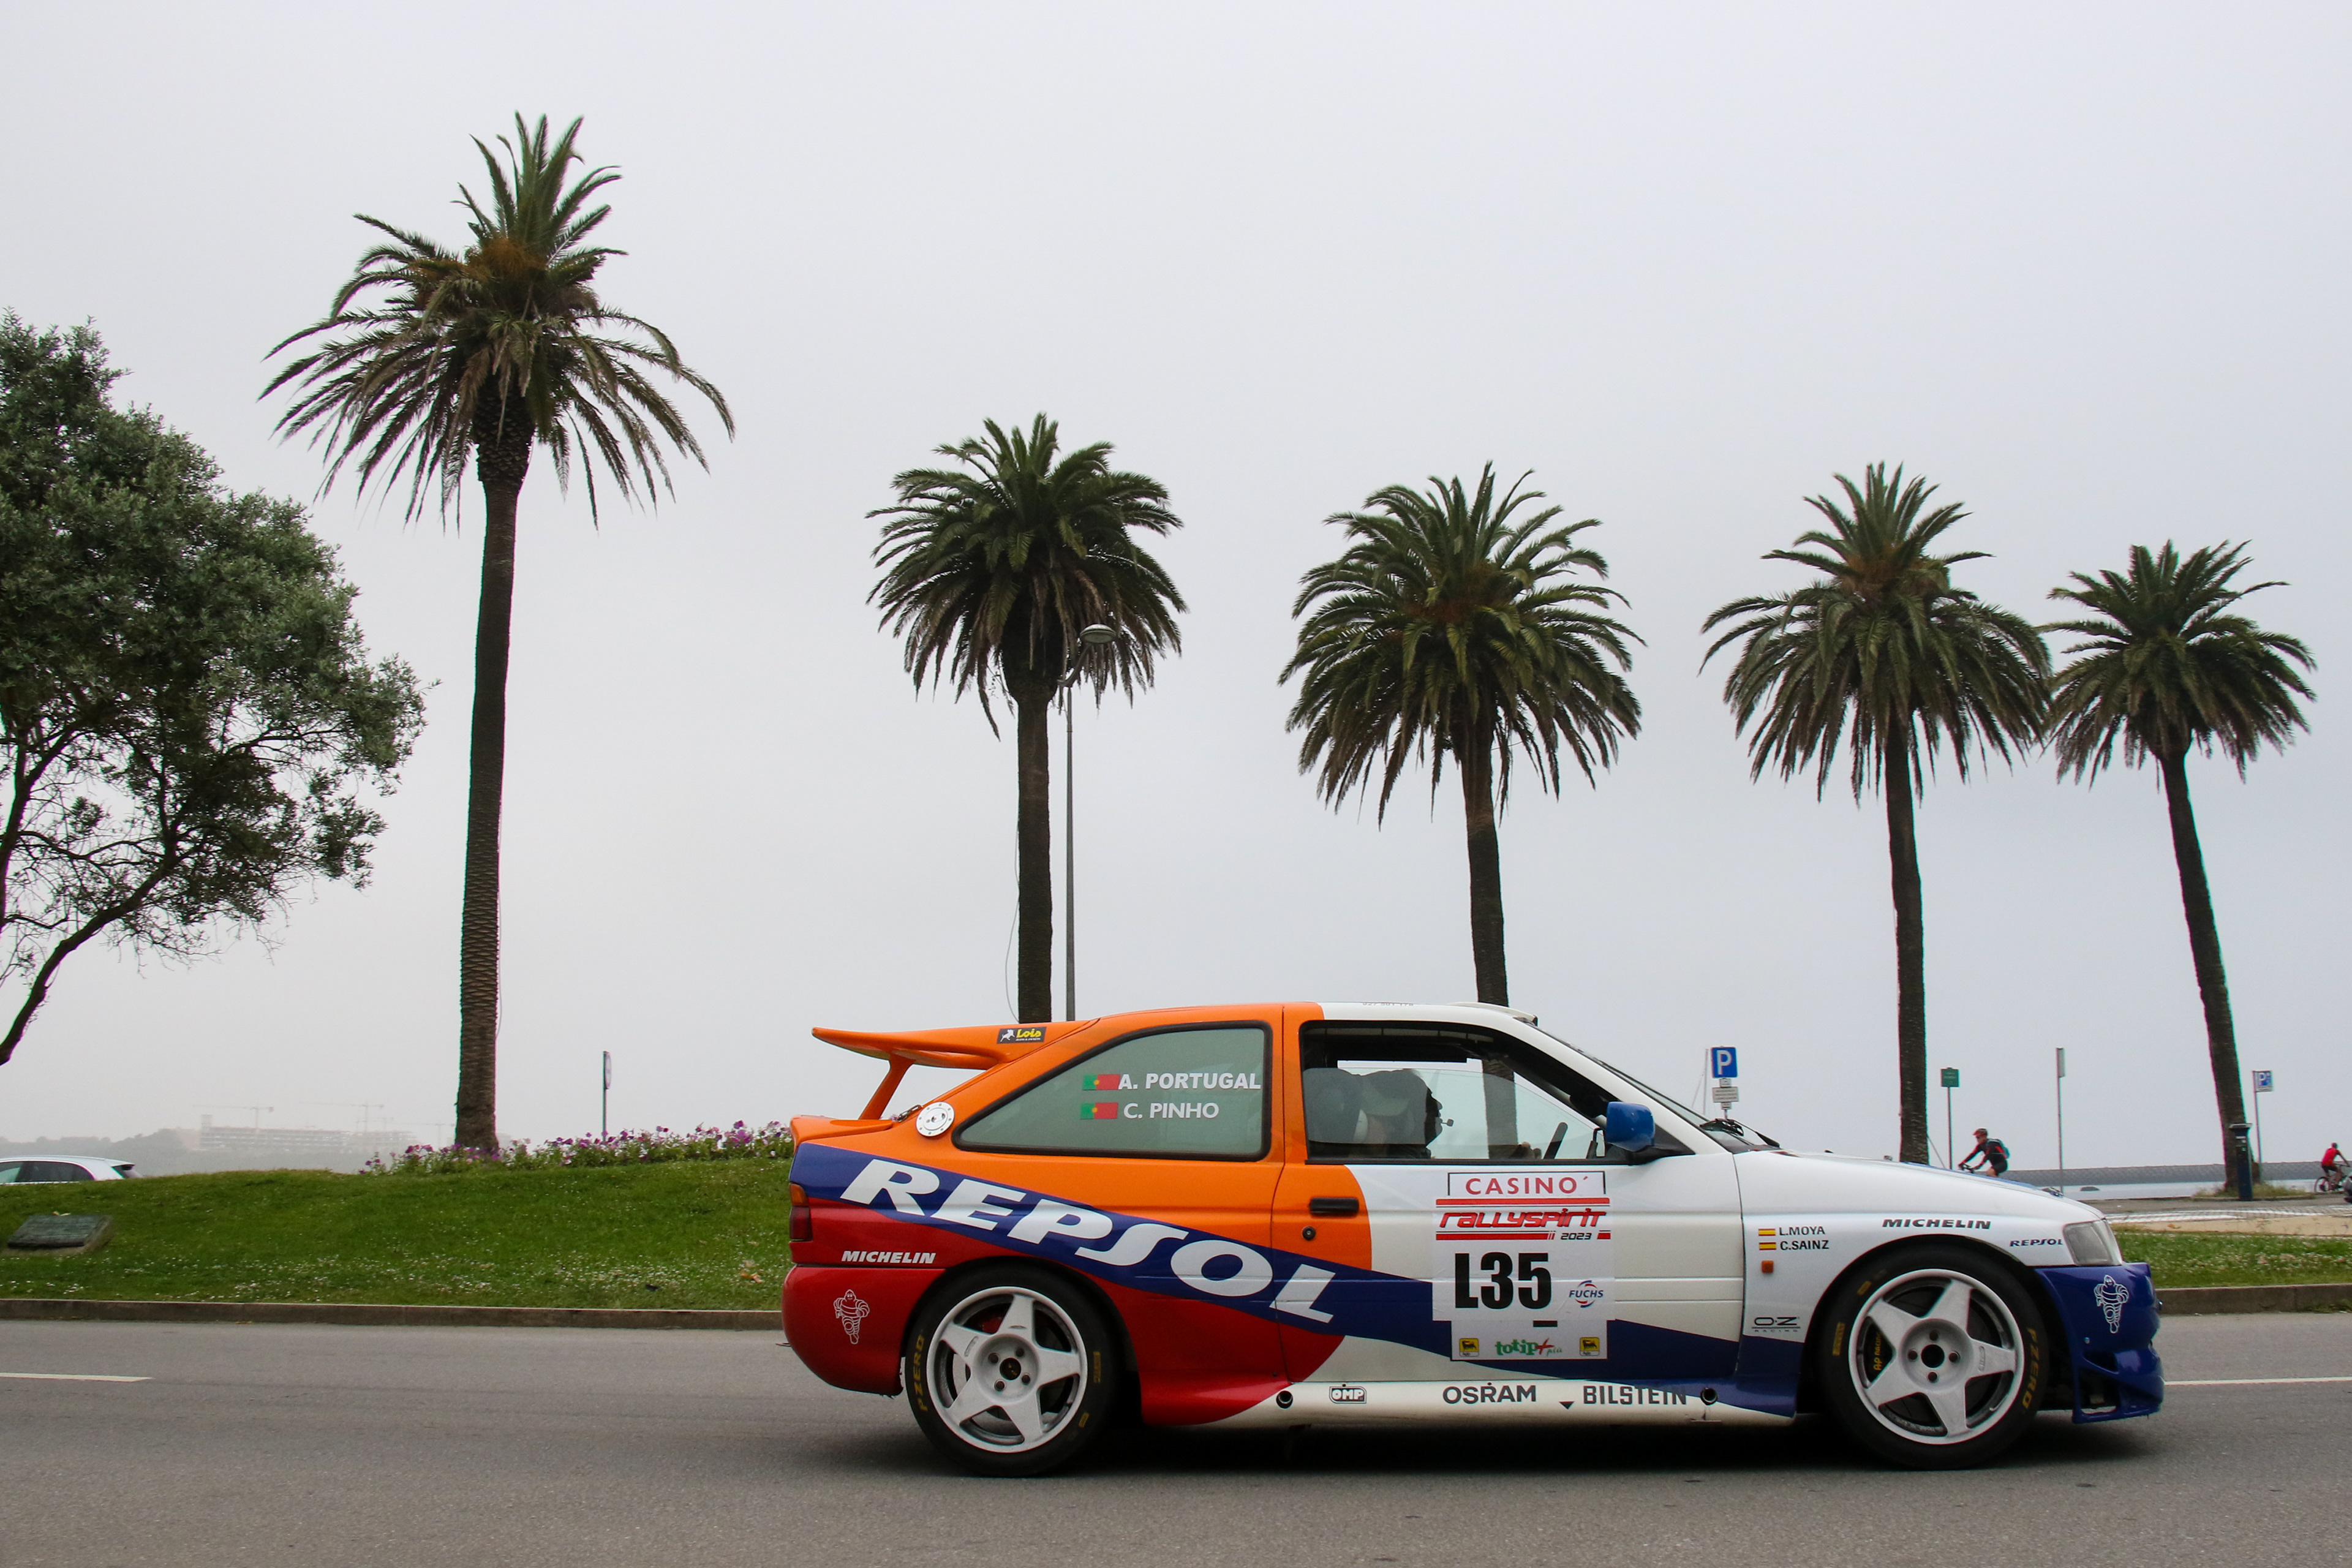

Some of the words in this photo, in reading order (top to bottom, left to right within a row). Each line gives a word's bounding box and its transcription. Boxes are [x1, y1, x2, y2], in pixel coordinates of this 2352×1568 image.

[1016, 1028, 1042, 1038] Lois
[1717, 1050, 1732, 1076] P
[1118, 1074, 1138, 1090] A.
[1145, 1072, 1261, 1090] PORTUGAL
[1123, 1103, 1143, 1118] C.
[1150, 1102, 1219, 1118] PINHO
[1882, 1219, 1991, 1229] MICHELIN
[840, 1159, 1336, 1324] REPSOL
[1780, 1240, 1830, 1250] C.SAINZ
[2010, 1238, 2063, 1247] REPSOL
[841, 1251, 936, 1264] MICHELIN
[1455, 1251, 1551, 1310] L35
[1569, 1289, 1604, 1298] FUCHS
[1332, 1389, 1365, 1401] OMP
[1442, 1385, 1537, 1404] OSRAM
[1583, 1385, 1687, 1404] BILSTEIN
